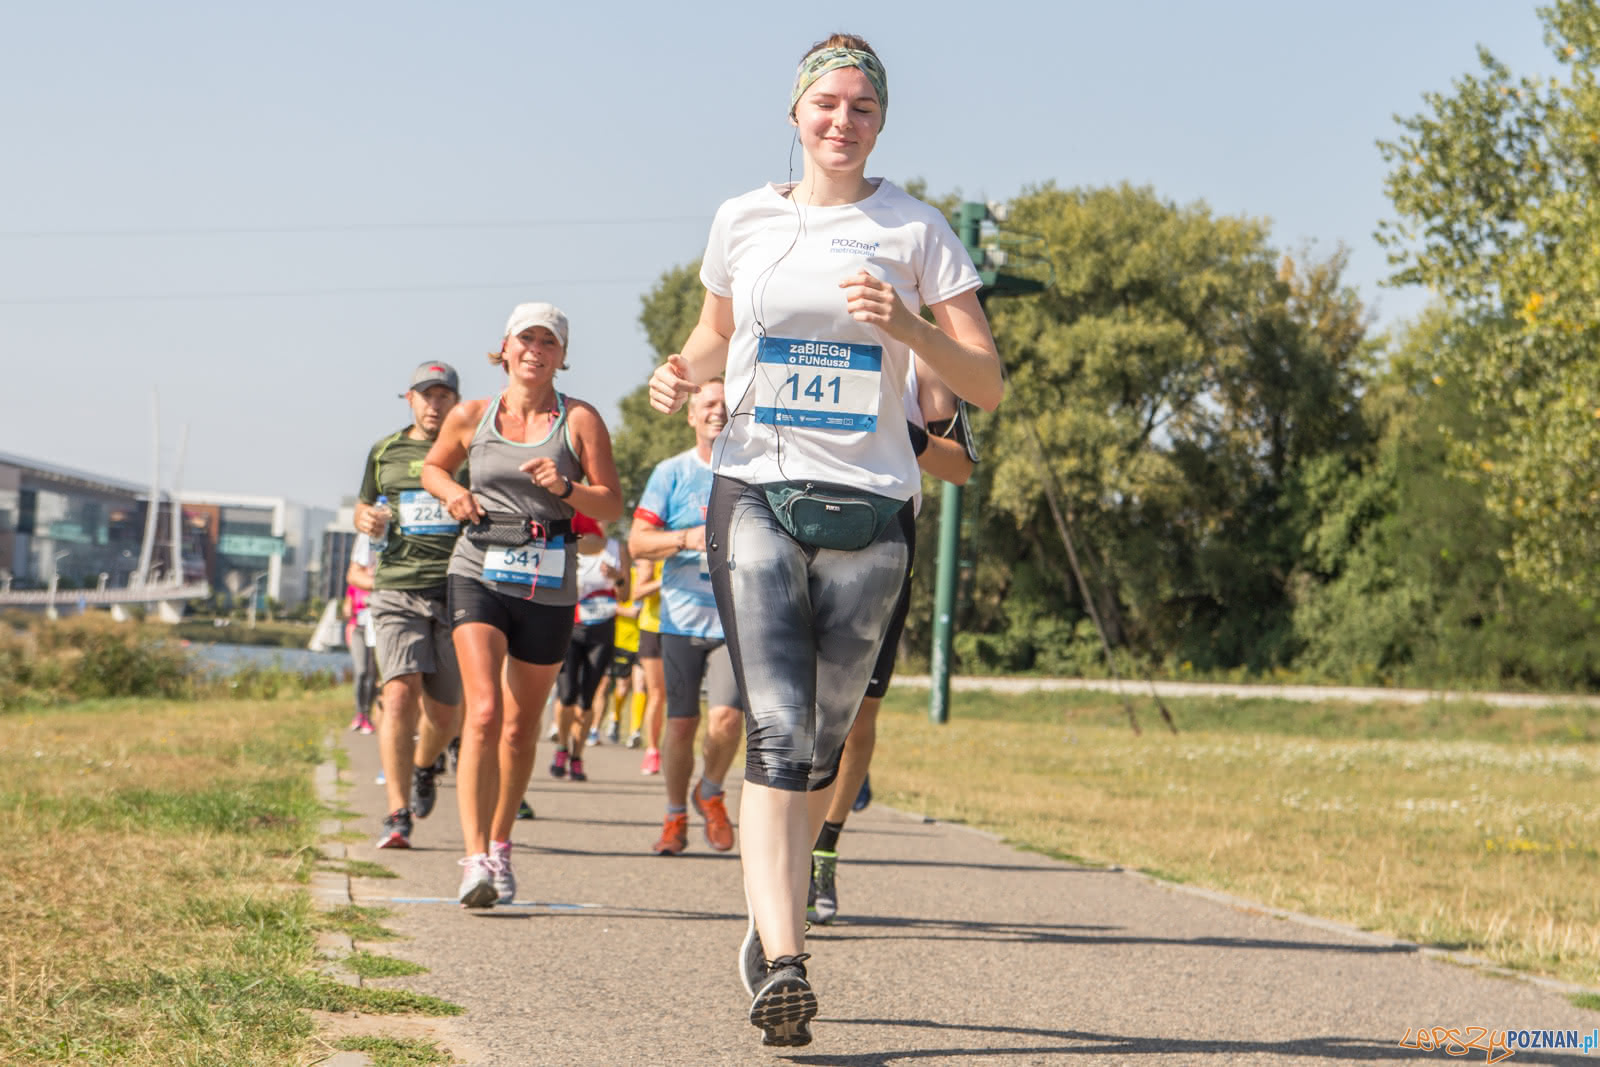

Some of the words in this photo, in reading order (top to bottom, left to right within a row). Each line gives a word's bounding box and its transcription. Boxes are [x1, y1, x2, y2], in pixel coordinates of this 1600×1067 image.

[790, 343, 851, 360] zaBIEGaj
[788, 355, 797, 364] o
[798, 355, 850, 368] FUNdusze
[786, 372, 841, 404] 141
[414, 504, 443, 520] 224
[504, 548, 540, 569] 541
